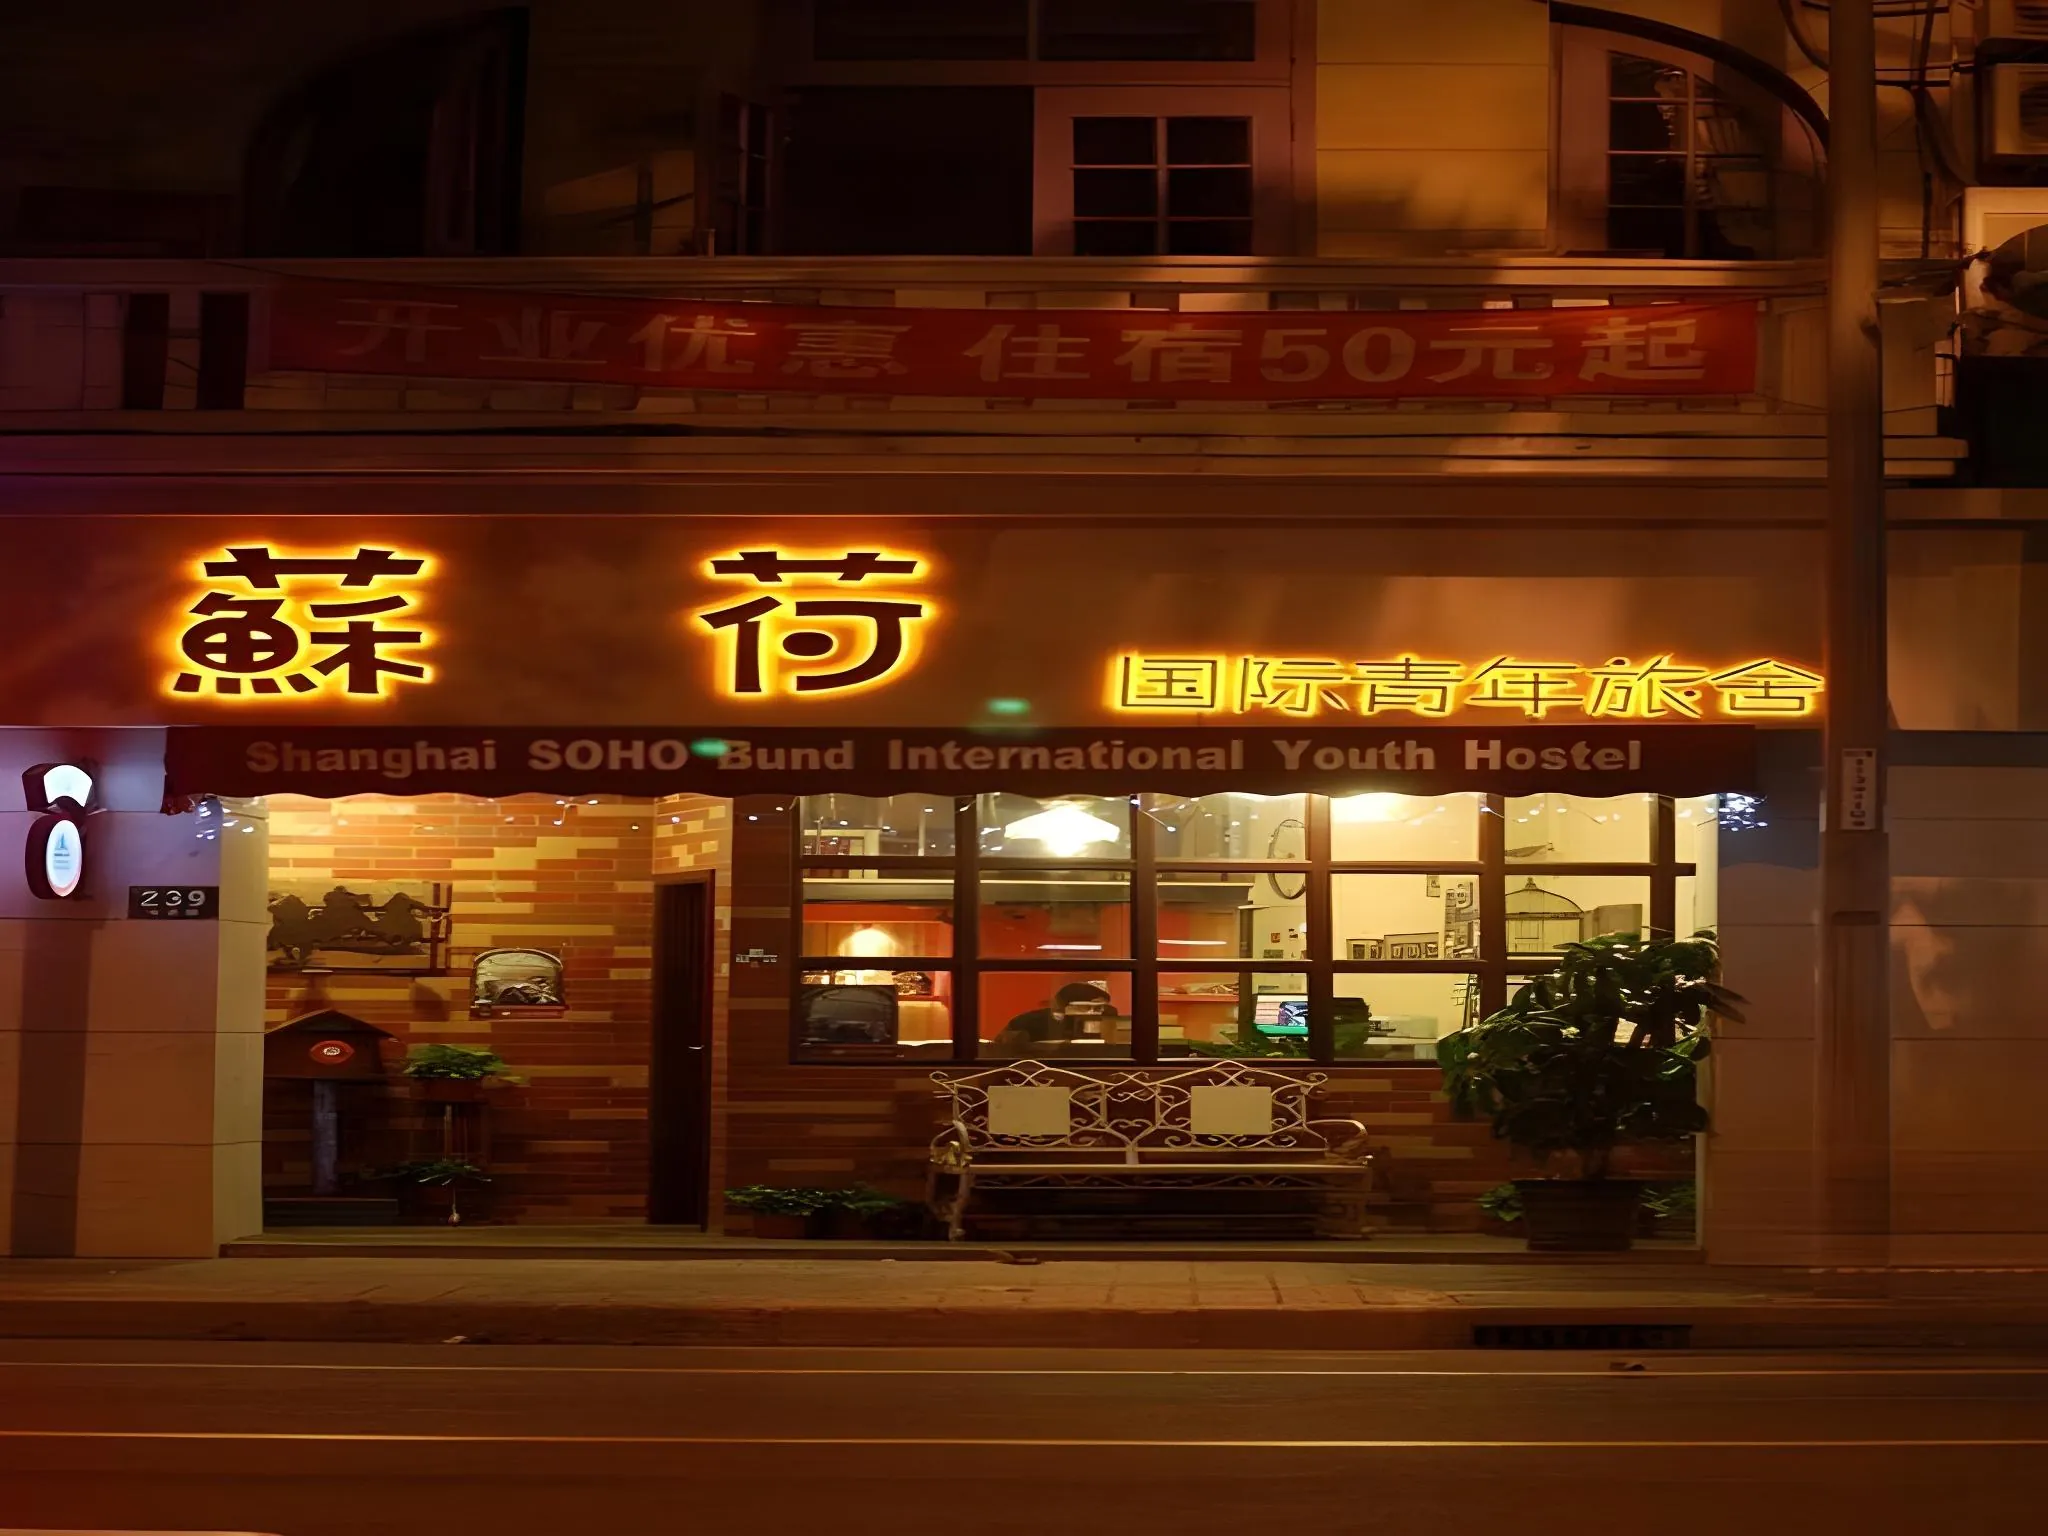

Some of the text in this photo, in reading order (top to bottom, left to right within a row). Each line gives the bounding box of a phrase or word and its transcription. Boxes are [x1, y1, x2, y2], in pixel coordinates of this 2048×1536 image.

[1119, 653, 1824, 718] 国际青年旅舍
[245, 738, 1642, 780] Shanghai SOHO Bund International Youth Hostel
[140, 890, 206, 907] 239
